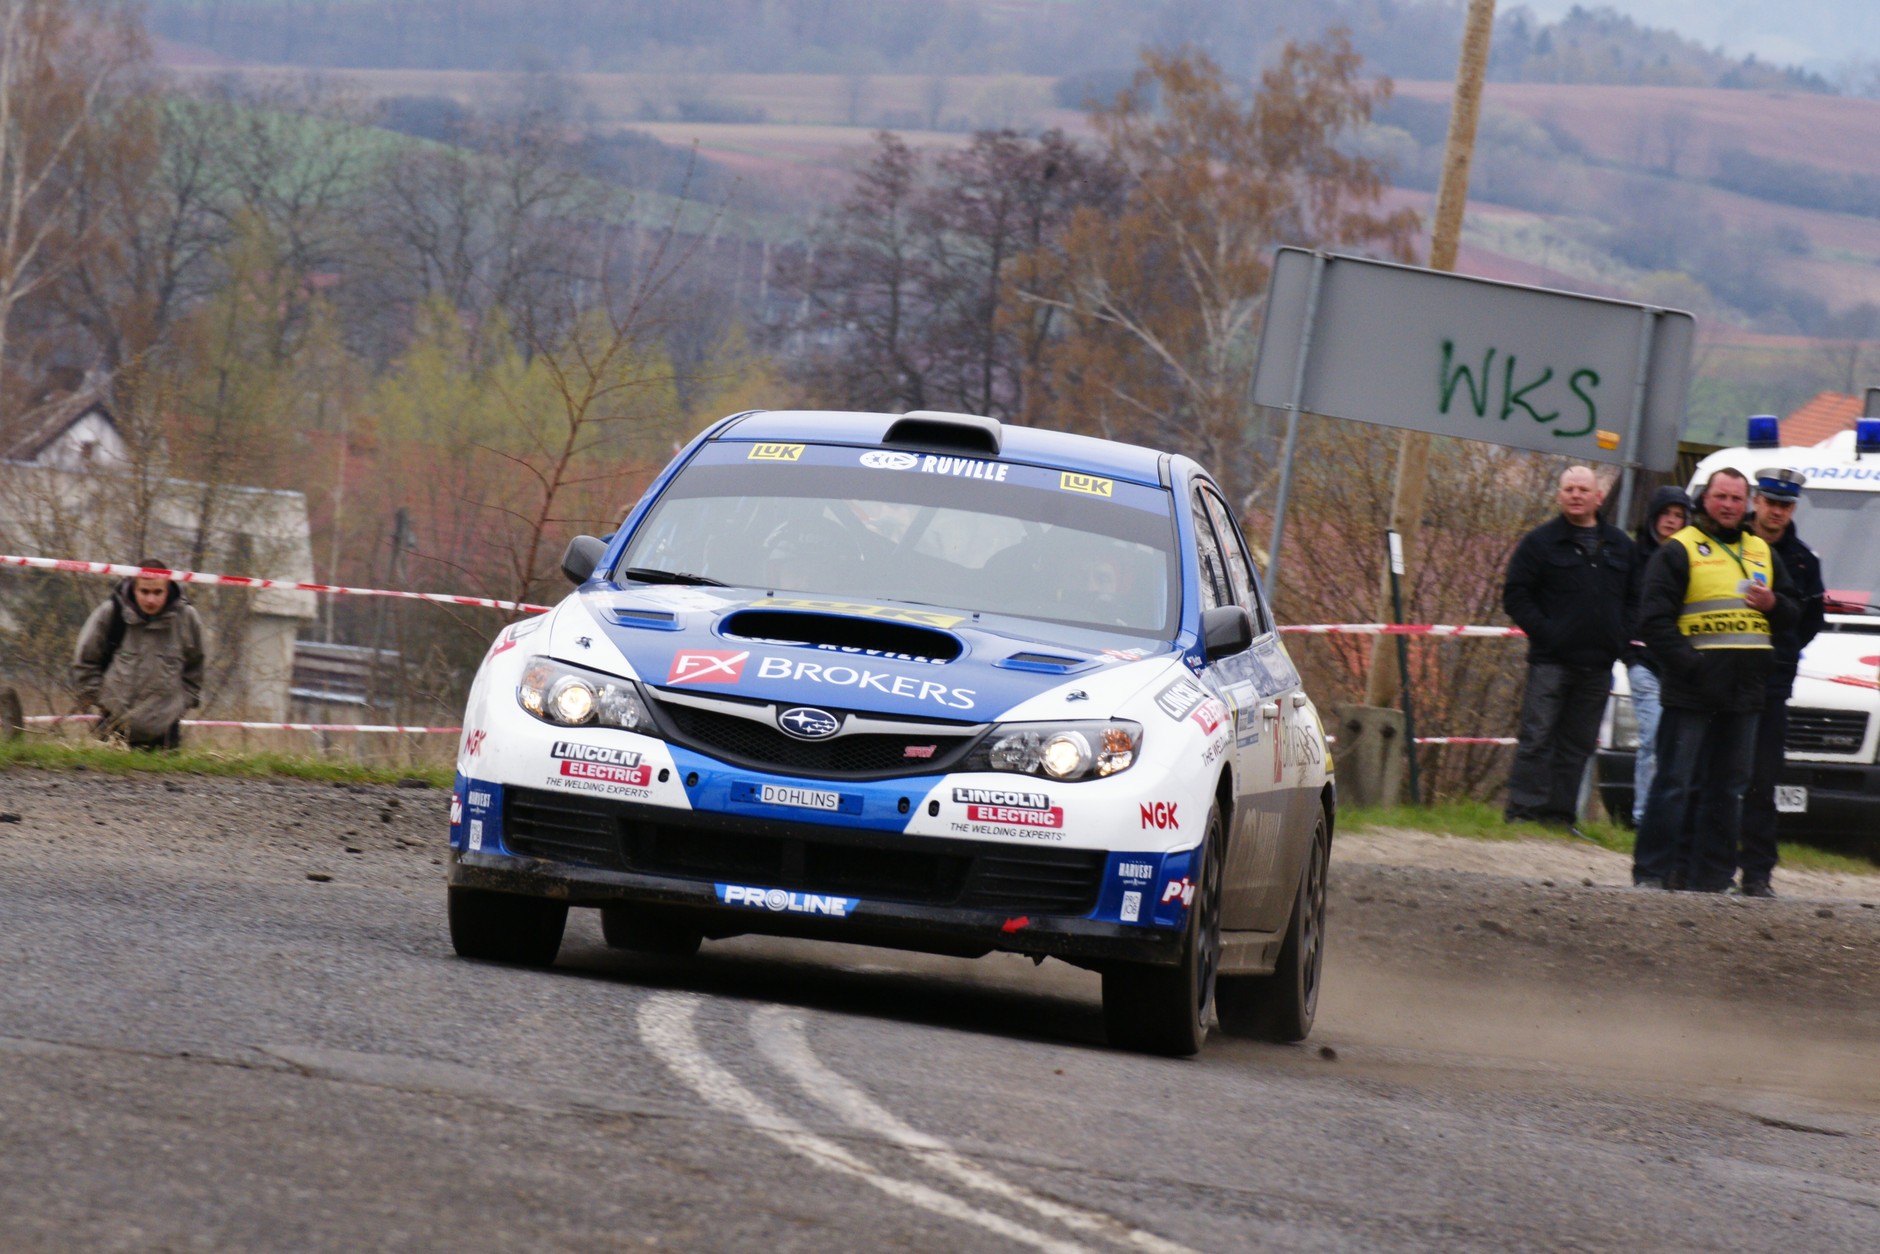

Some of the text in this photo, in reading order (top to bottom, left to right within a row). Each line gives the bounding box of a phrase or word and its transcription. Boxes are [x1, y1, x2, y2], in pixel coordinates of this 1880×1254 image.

[1440, 339, 1600, 437] WKS
[921, 455, 1009, 482] RUVILLE
[666, 651, 977, 710] FX BROKERS
[464, 728, 486, 756] NGK
[554, 742, 638, 766] LINCOLN
[569, 763, 642, 783] ELECTRIC
[546, 776, 650, 799] THE WELDING EXPERTS
[956, 788, 1047, 808] LINCOLN
[977, 806, 1055, 825] ELECTRIC
[1140, 801, 1180, 830] NGK
[950, 823, 1063, 841] THE WELDING EXPERTS
[1118, 863, 1153, 879] HARVEST
[724, 885, 847, 916] PROLINE
